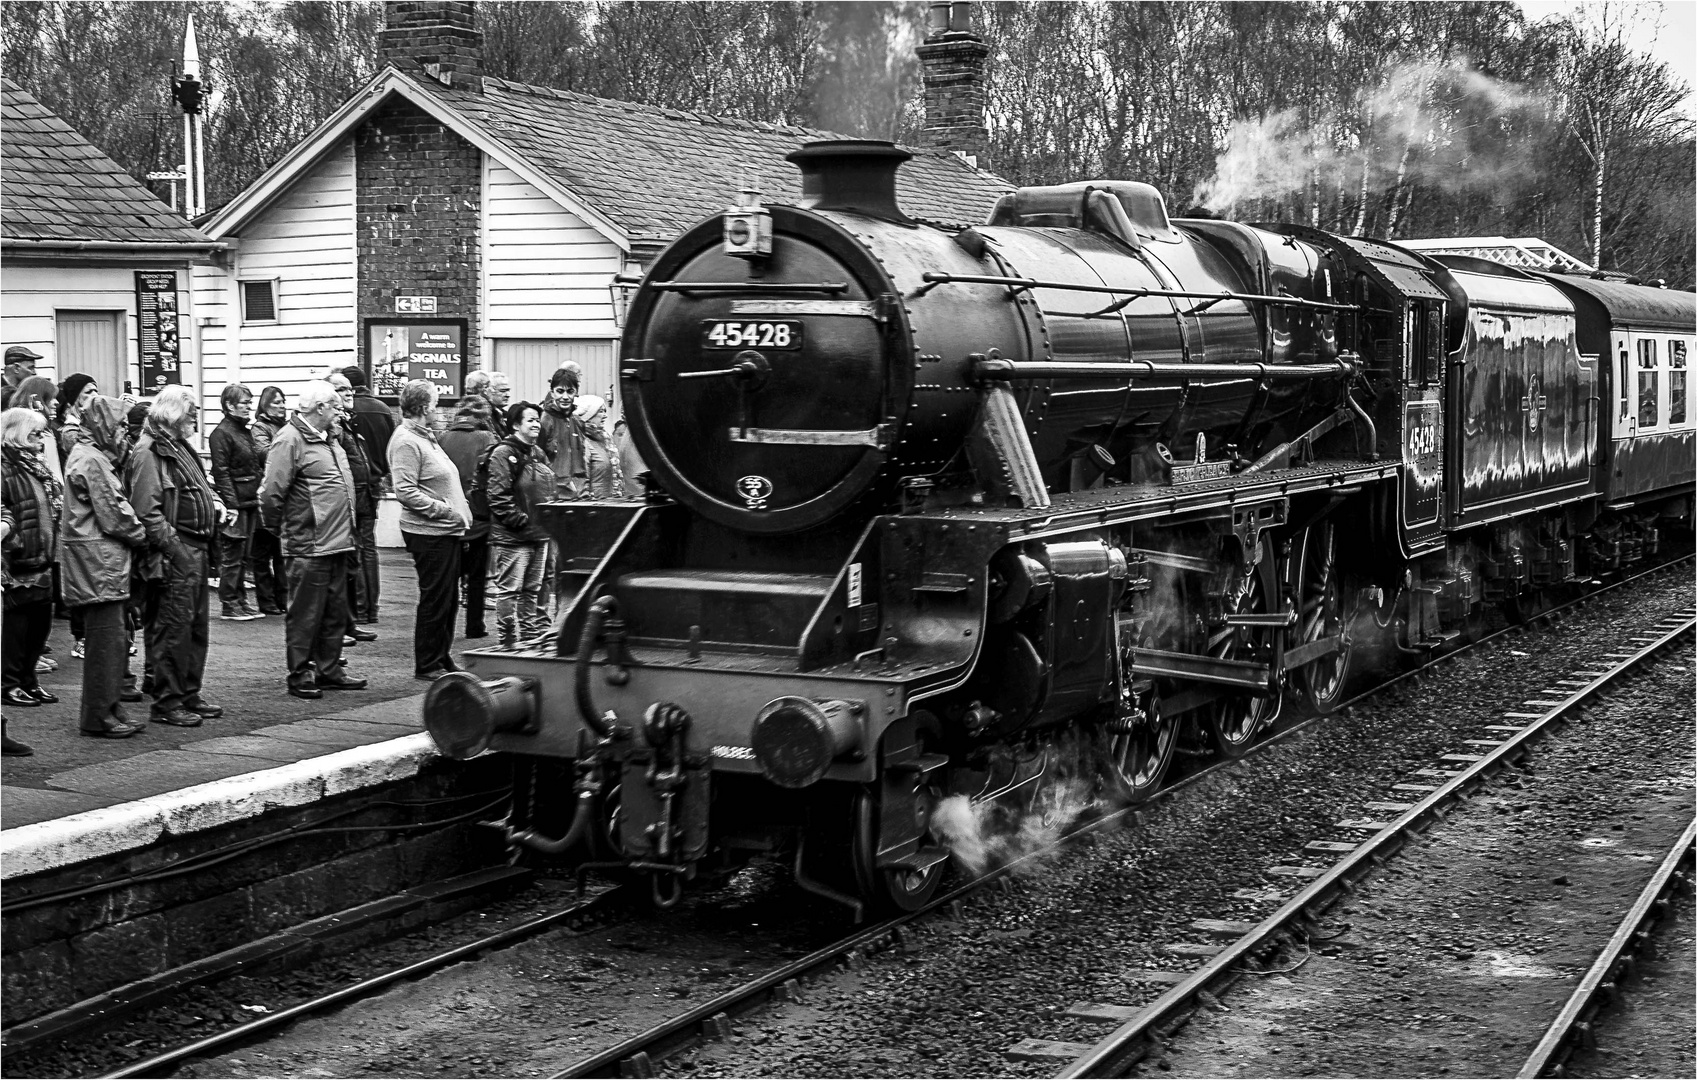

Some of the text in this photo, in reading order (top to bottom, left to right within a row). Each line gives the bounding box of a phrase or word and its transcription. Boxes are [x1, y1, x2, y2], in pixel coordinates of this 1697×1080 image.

[421, 332, 429, 340] A
[708, 322, 791, 347] 45428
[409, 353, 461, 363] SIGNALS
[422, 368, 447, 379] TEA
[433, 385, 454, 395] OM
[1409, 425, 1435, 455] 45428
